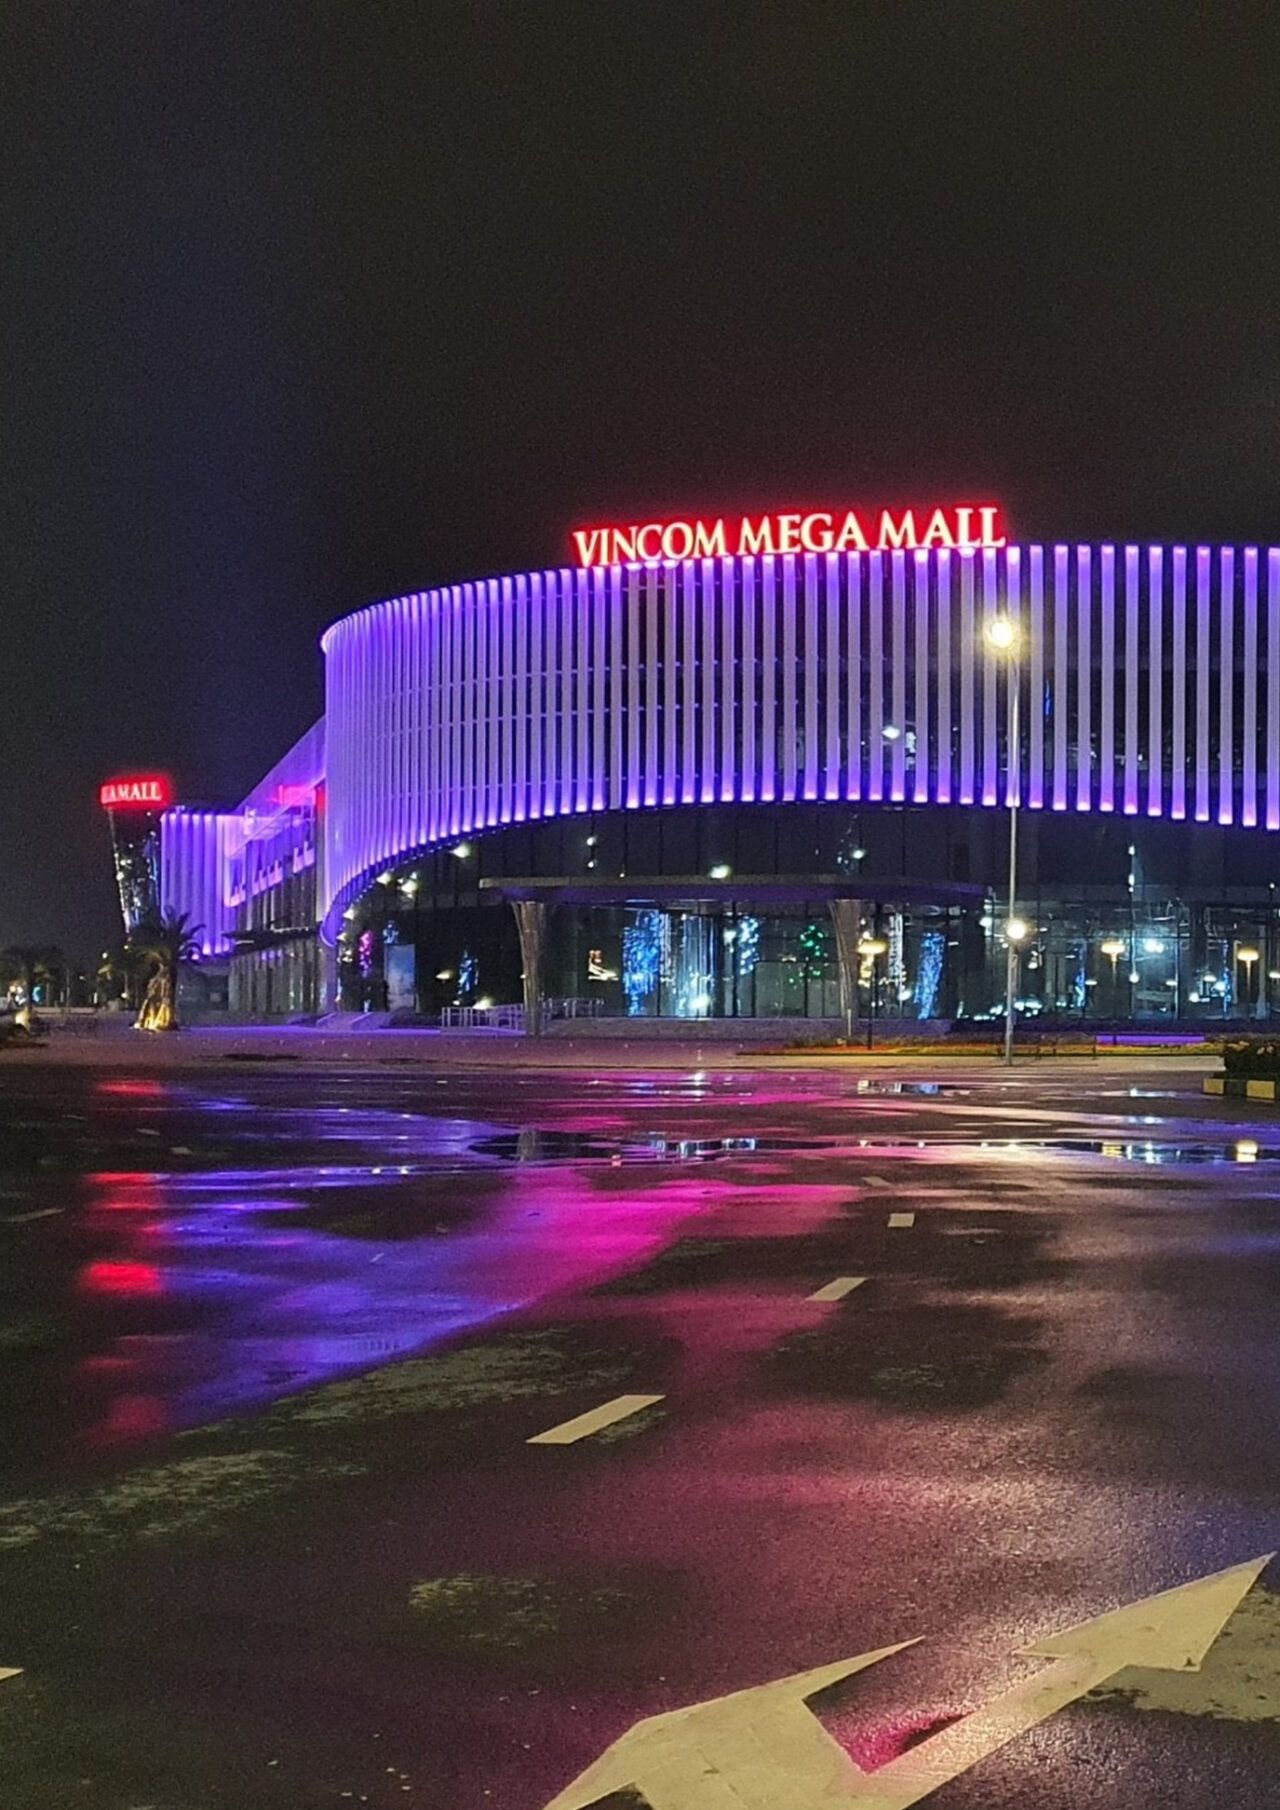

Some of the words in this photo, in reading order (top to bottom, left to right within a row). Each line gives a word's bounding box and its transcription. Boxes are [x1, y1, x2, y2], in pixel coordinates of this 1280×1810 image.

[573, 518, 730, 567] VINCOM
[736, 510, 870, 556] MEGA
[877, 508, 1006, 549] MALL
[117, 782, 162, 801] MALL
